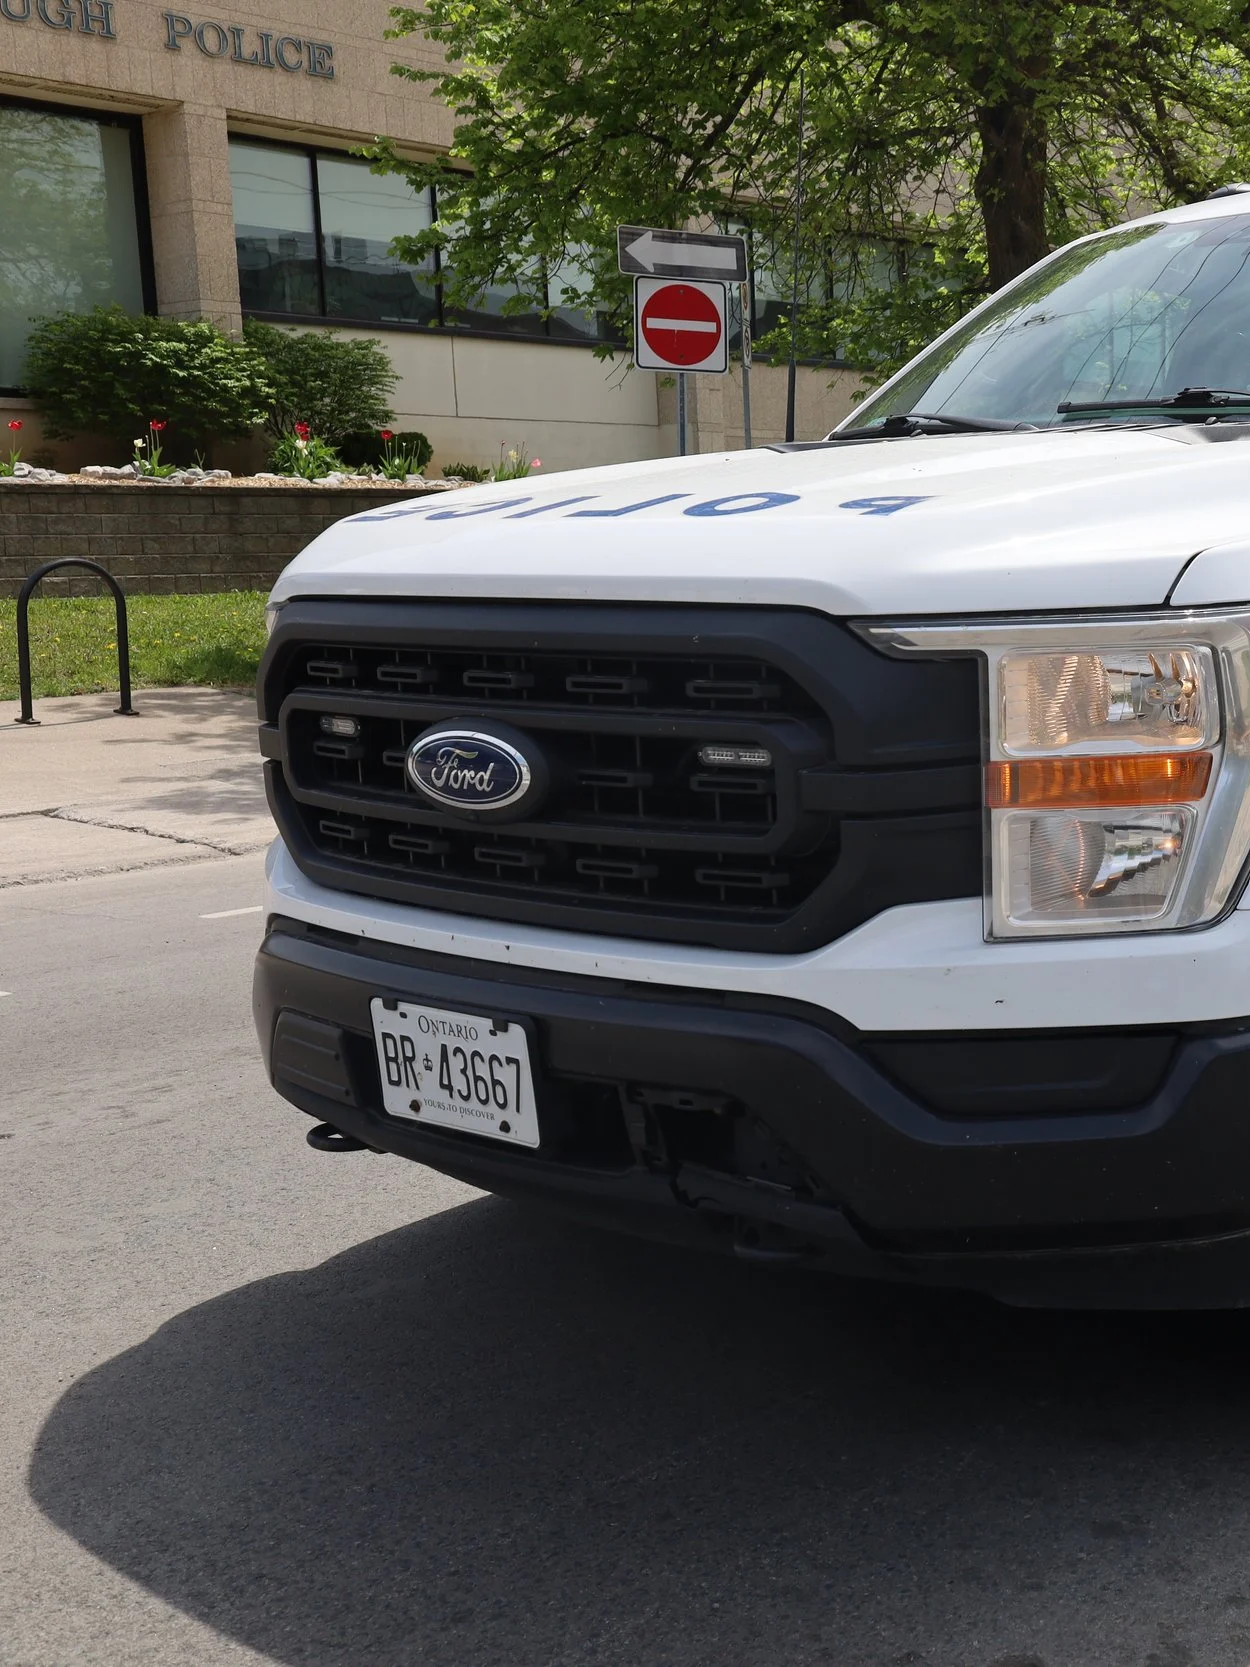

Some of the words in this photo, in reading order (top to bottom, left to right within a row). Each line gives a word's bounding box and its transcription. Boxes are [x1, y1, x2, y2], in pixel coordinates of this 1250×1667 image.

[0, 0, 117, 40] UGH
[162, 10, 335, 79] POLICE
[431, 747, 494, 792] Ford
[381, 1031, 421, 1091] BR
[438, 1043, 521, 1114] 43667
[424, 1098, 446, 1111] YOURS
[448, 1104, 458, 1113] TO
[459, 1106, 496, 1121] DISCOVER
